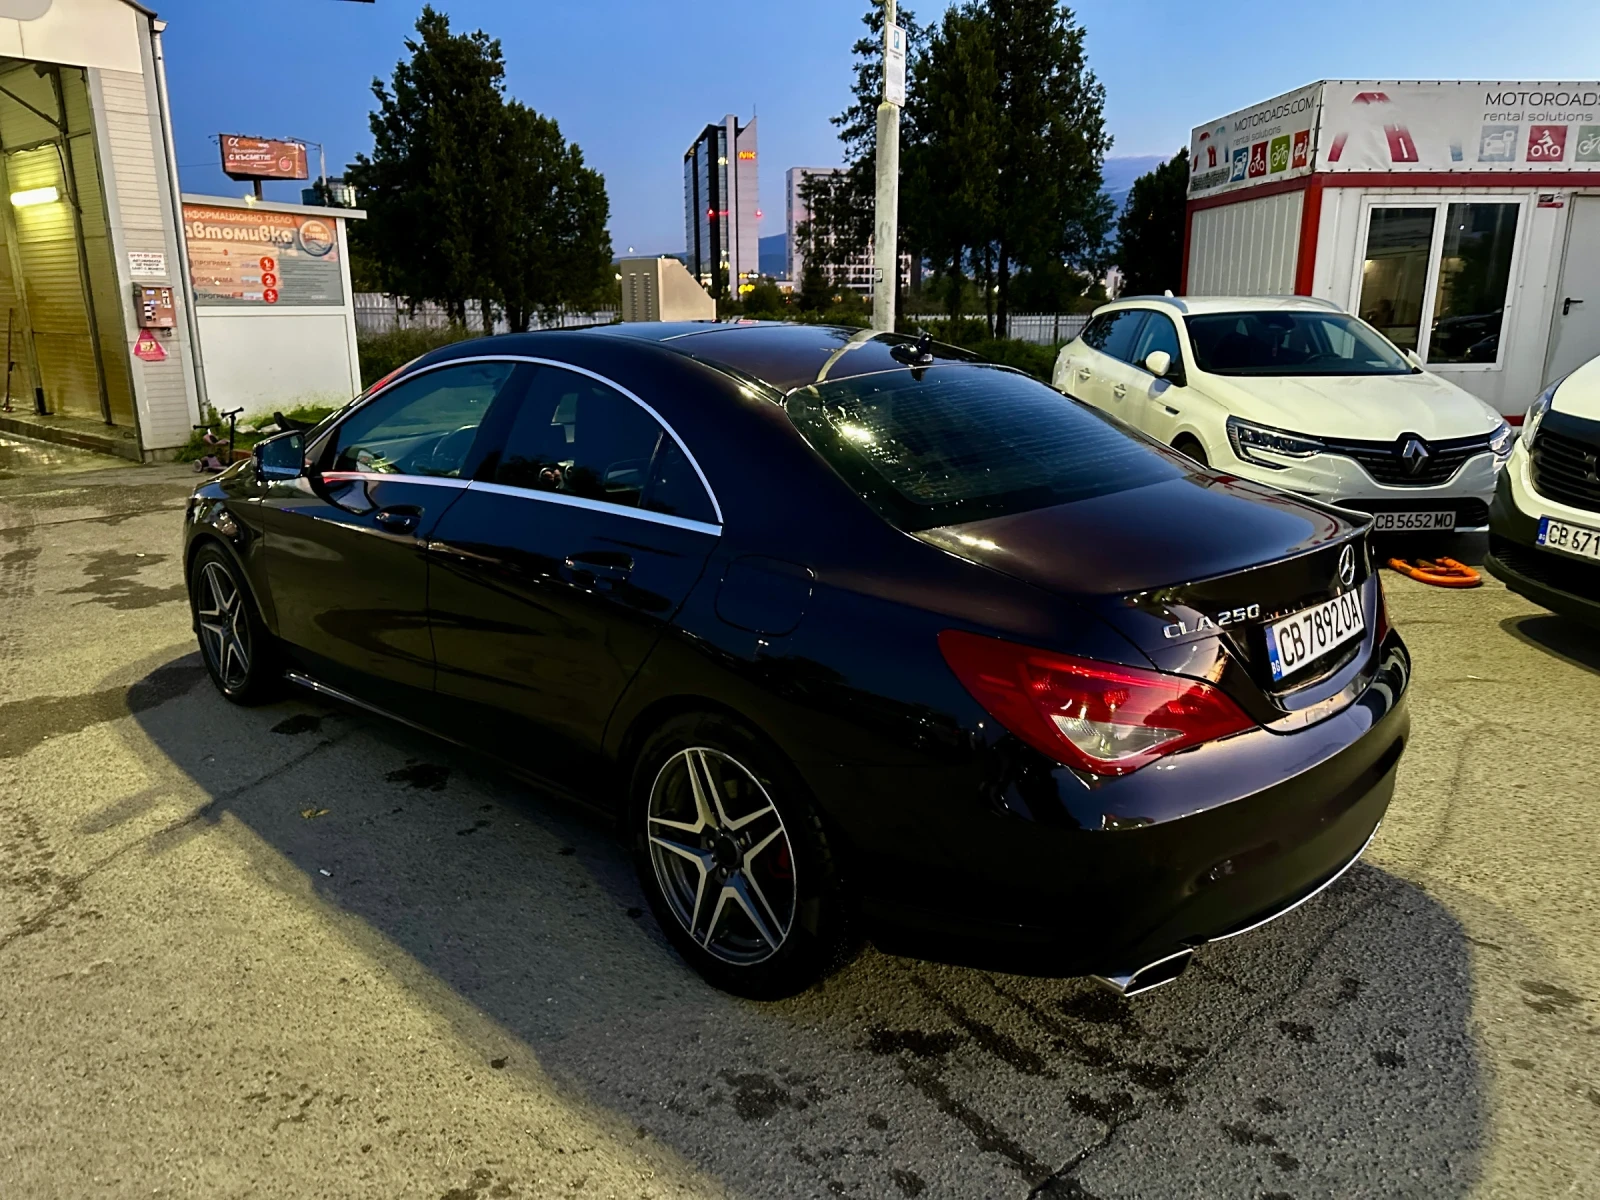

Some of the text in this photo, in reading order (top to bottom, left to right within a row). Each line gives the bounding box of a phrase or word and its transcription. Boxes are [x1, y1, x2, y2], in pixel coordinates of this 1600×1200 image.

[1485, 92, 1600, 106] MOTOROAD
[1234, 96, 1314, 132] MOTOROADS.COM
[1483, 110, 1593, 121] rental solutions
[1233, 125, 1281, 146] rental solutions
[183, 209, 262, 222] НФОРМАЦИОННО
[1375, 513, 1453, 529] CB 5652 MO
[1549, 524, 1600, 556] CB 671
[1163, 603, 1260, 639] CLA 250
[1279, 592, 1361, 666] CB 7892 OA
[1270, 660, 1281, 676] BG
